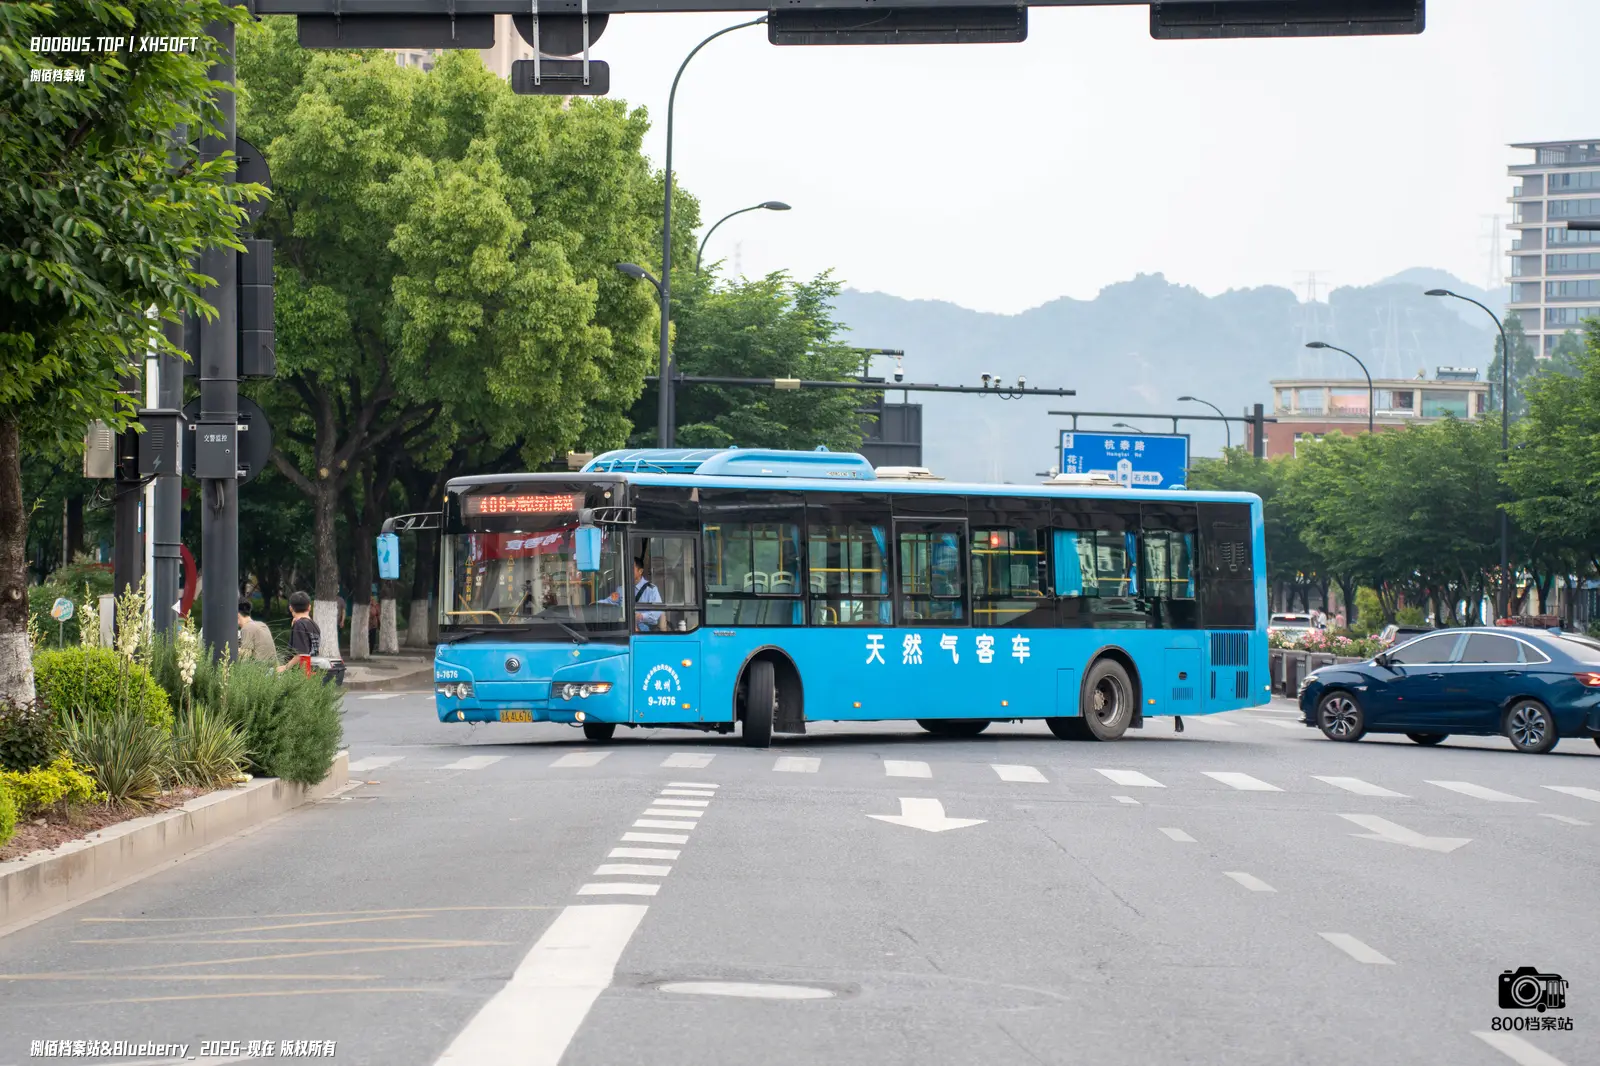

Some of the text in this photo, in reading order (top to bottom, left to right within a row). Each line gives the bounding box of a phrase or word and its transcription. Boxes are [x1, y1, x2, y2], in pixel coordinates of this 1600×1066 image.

[1104, 439, 1145, 451] 杭泰路
[865, 633, 1031, 665] 天然气客车
[436, 670, 459, 679] 9-7676
[648, 696, 676, 706] 9-7676
